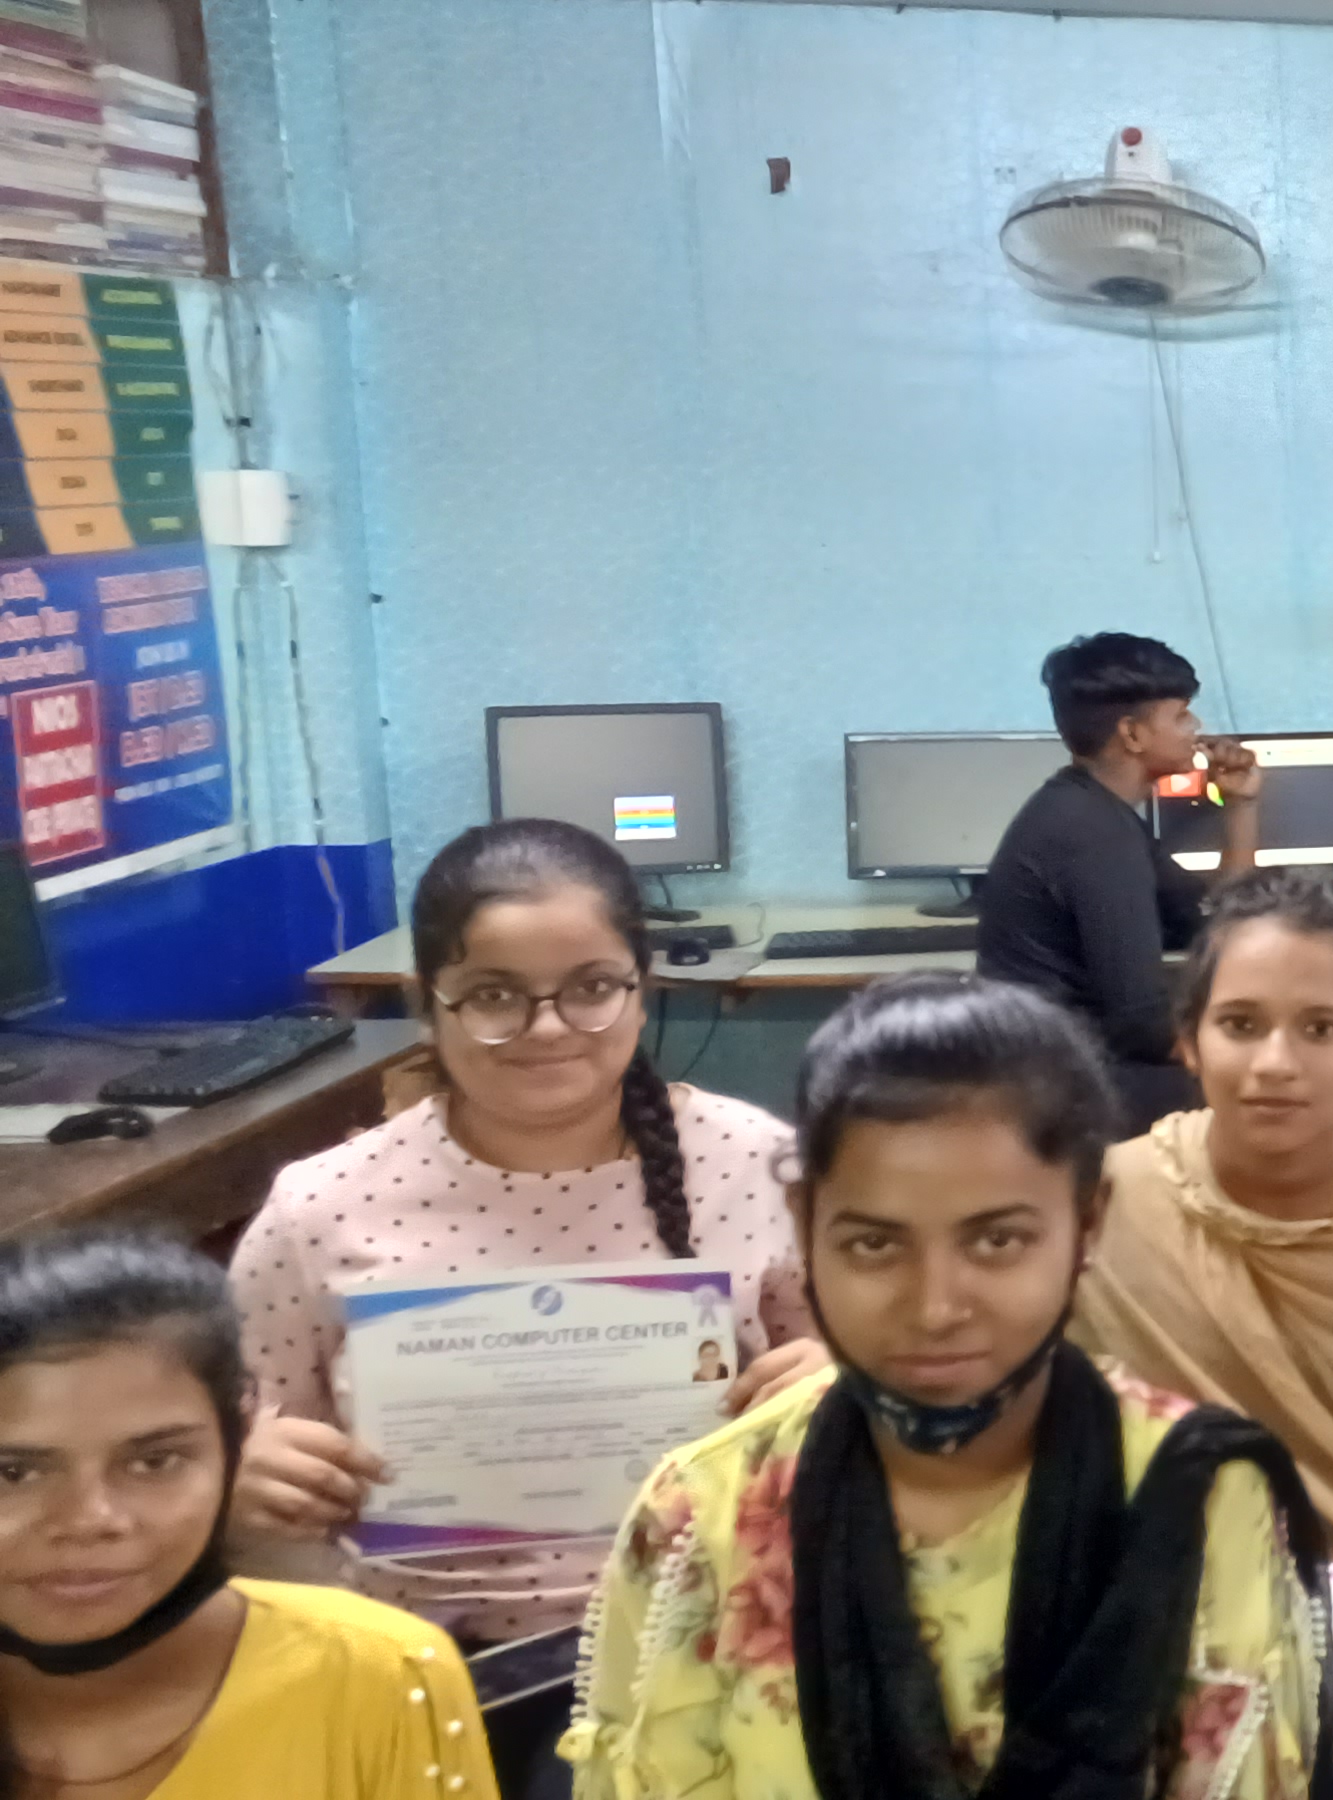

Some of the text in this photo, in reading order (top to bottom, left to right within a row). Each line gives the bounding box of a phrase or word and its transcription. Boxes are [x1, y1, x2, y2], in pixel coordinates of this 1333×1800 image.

[397, 1321, 689, 1357] NAMAN COMPUTER CENTER
